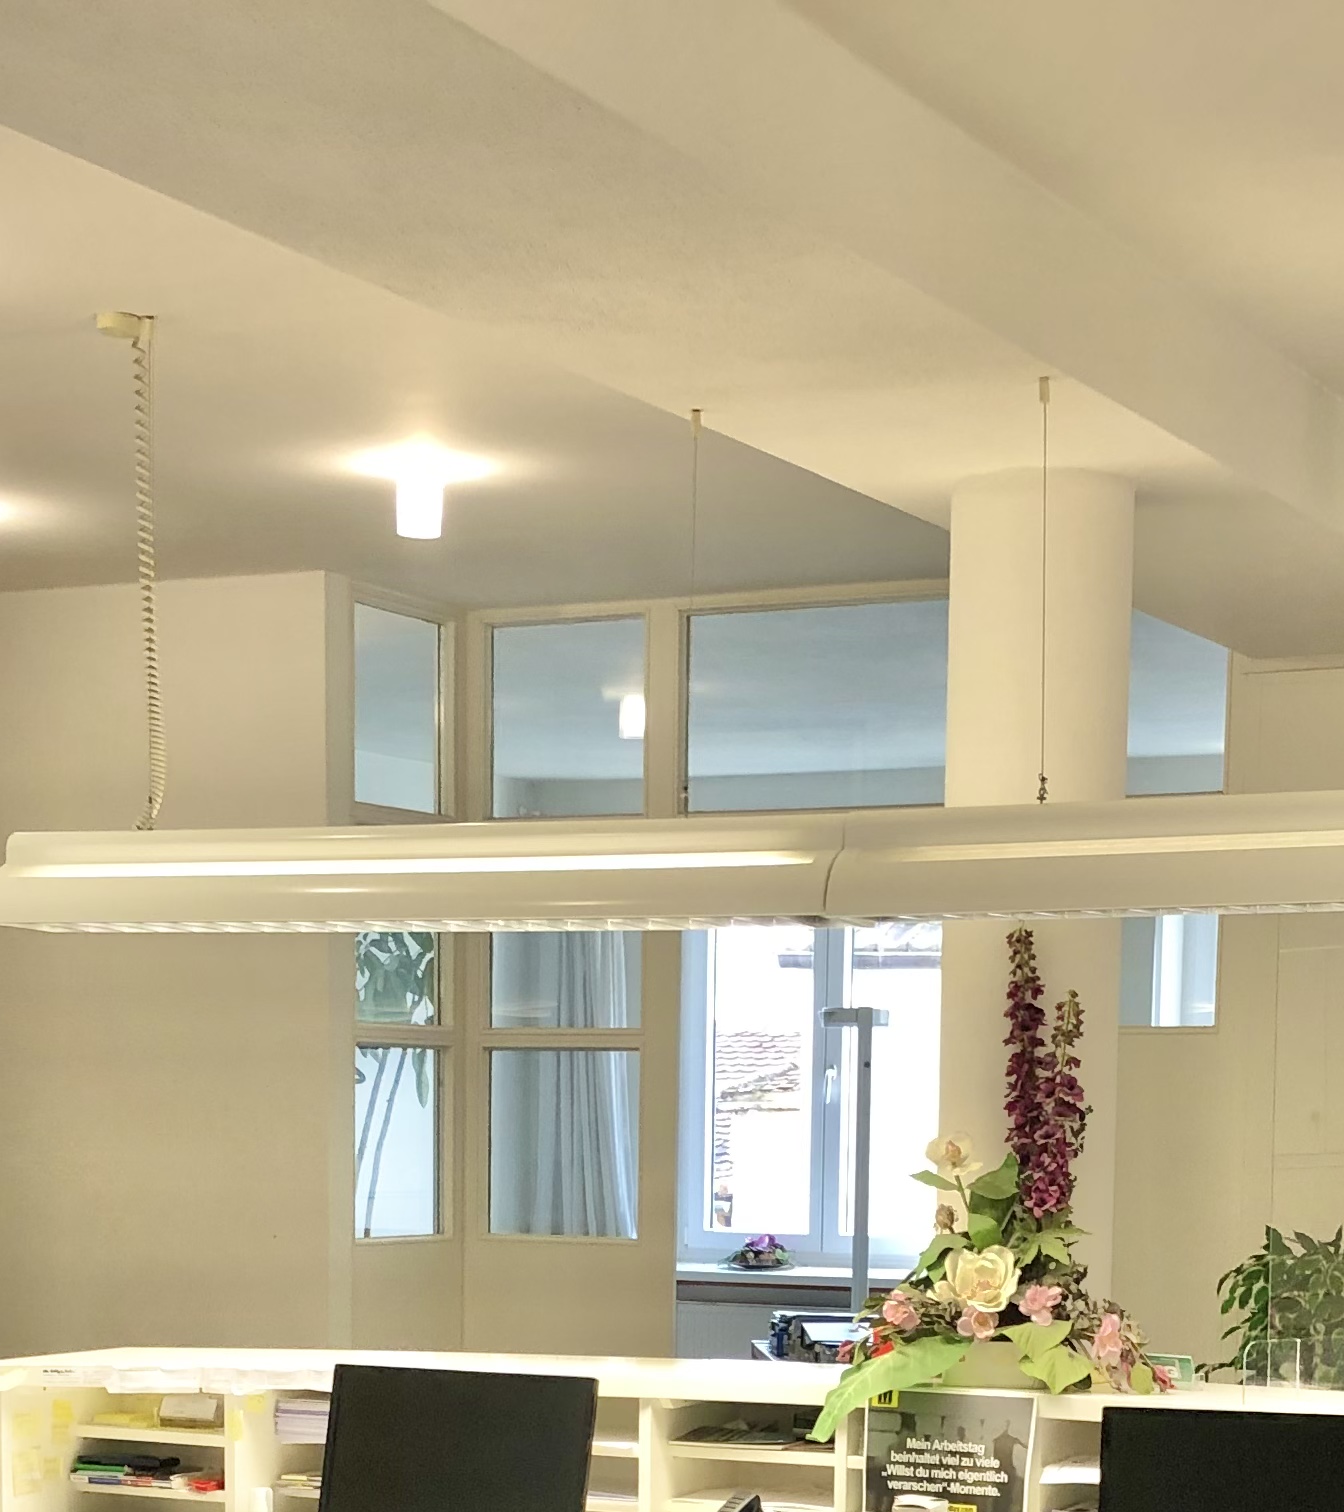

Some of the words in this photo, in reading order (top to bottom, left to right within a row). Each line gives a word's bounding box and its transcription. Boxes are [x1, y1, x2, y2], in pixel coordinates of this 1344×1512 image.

[906, 1437, 931, 1450] Mein
[932, 1439, 986, 1456] Arbeitstag
[890, 1450, 940, 1465] beinhaltet
[941, 1454, 960, 1466] viel
[961, 1457, 974, 1467] zu
[975, 1456, 1000, 1468] viele
[915, 1466, 929, 1478] du
[930, 1468, 956, 1480] mich
[958, 1469, 1009, 1483] eigentlich
